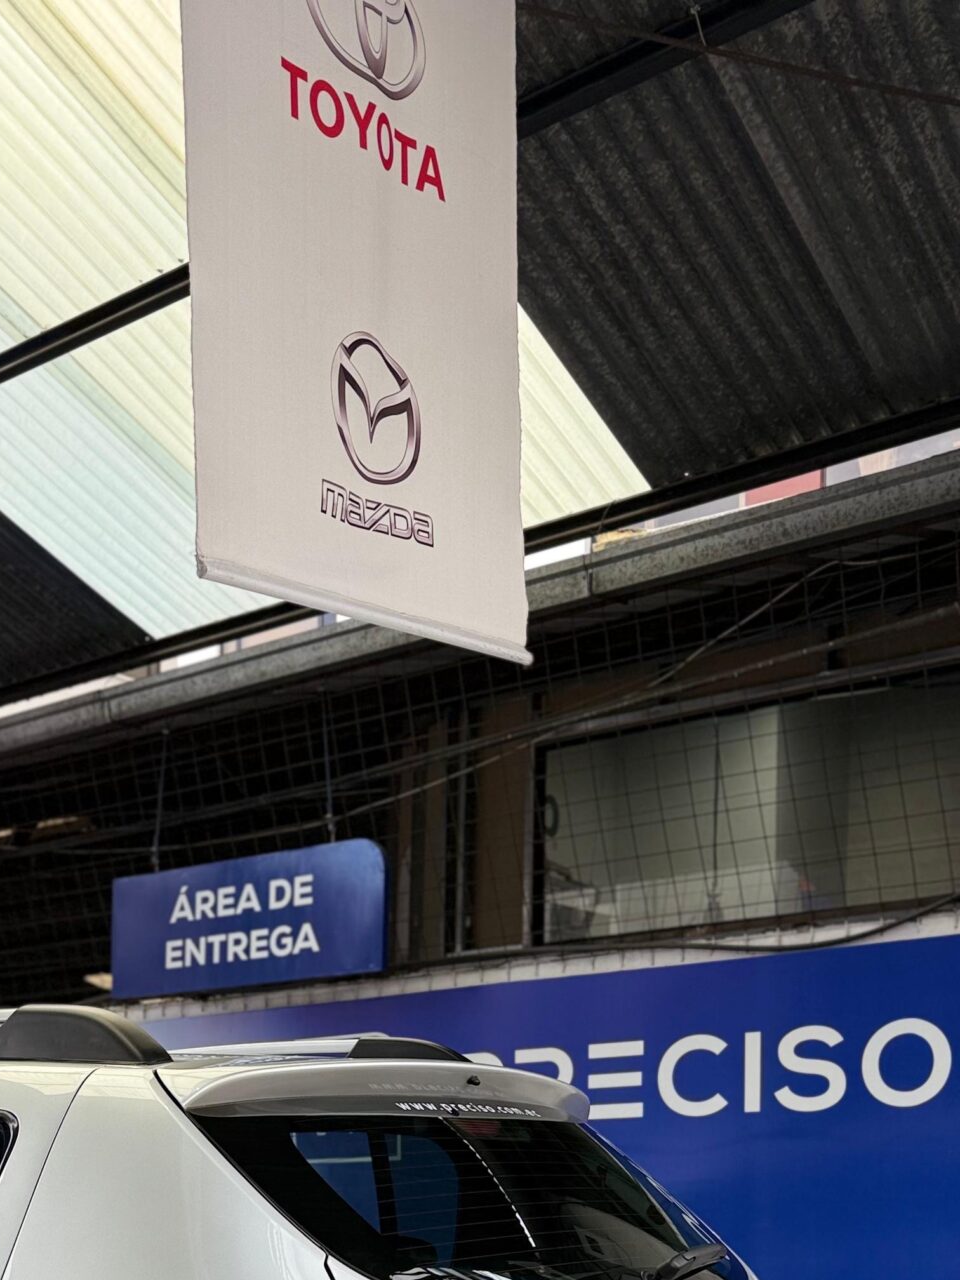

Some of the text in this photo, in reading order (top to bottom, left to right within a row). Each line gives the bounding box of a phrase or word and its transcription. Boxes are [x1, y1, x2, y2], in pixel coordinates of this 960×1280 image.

[280, 55, 446, 202] TOYOTA
[169, 874, 314, 924] ÁREA DE
[165, 922, 320, 970] ENTREGA
[462, 1017, 952, 1121] ECISO
